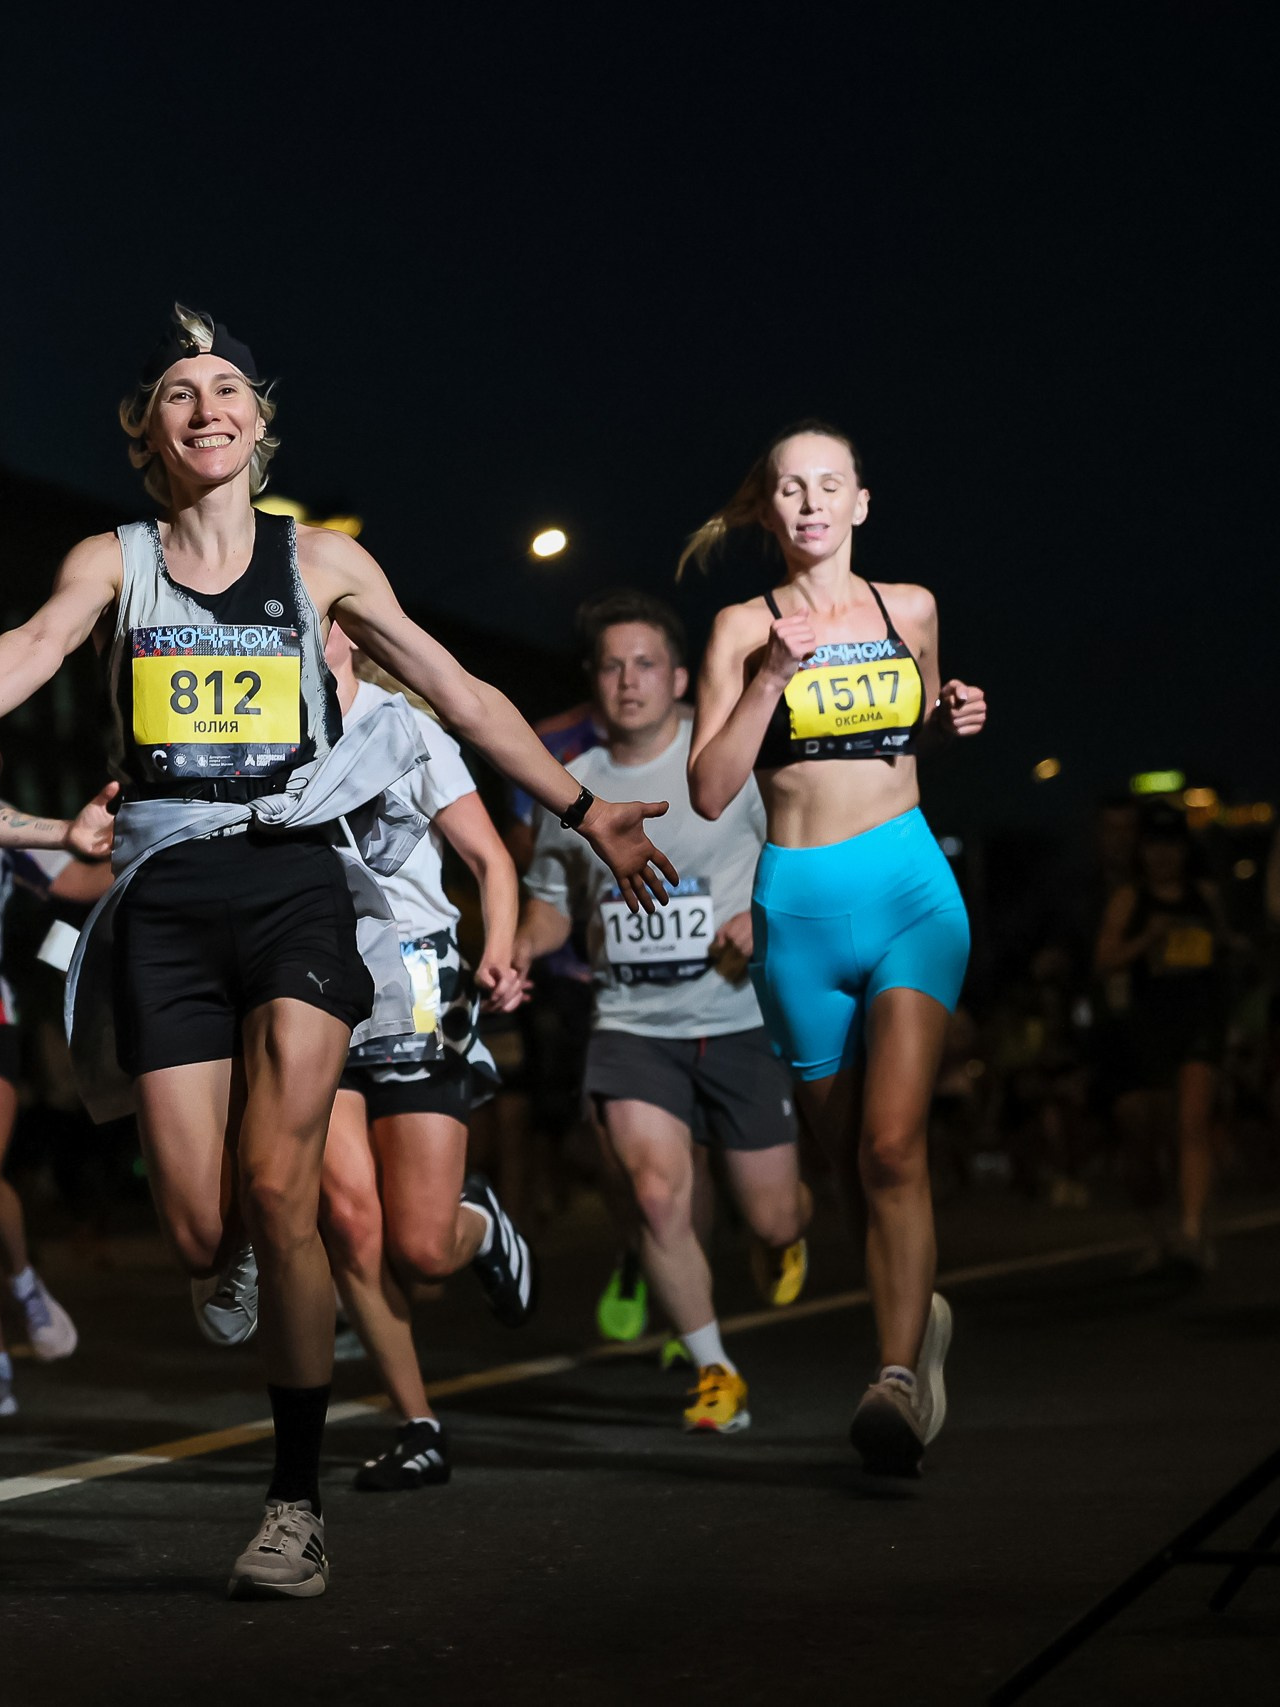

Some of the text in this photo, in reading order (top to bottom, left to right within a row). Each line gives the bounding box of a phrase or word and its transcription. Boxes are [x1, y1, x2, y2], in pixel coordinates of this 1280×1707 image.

[151, 626, 282, 649] НОЧНОЙ
[808, 639, 896, 664] ОЧНОЙ
[170, 670, 262, 715] 812
[807, 671, 899, 714] 1517
[193, 721, 239, 733] ЮЛИЯ
[835, 711, 883, 727] ОКСАНА
[608, 908, 707, 943] 13012
